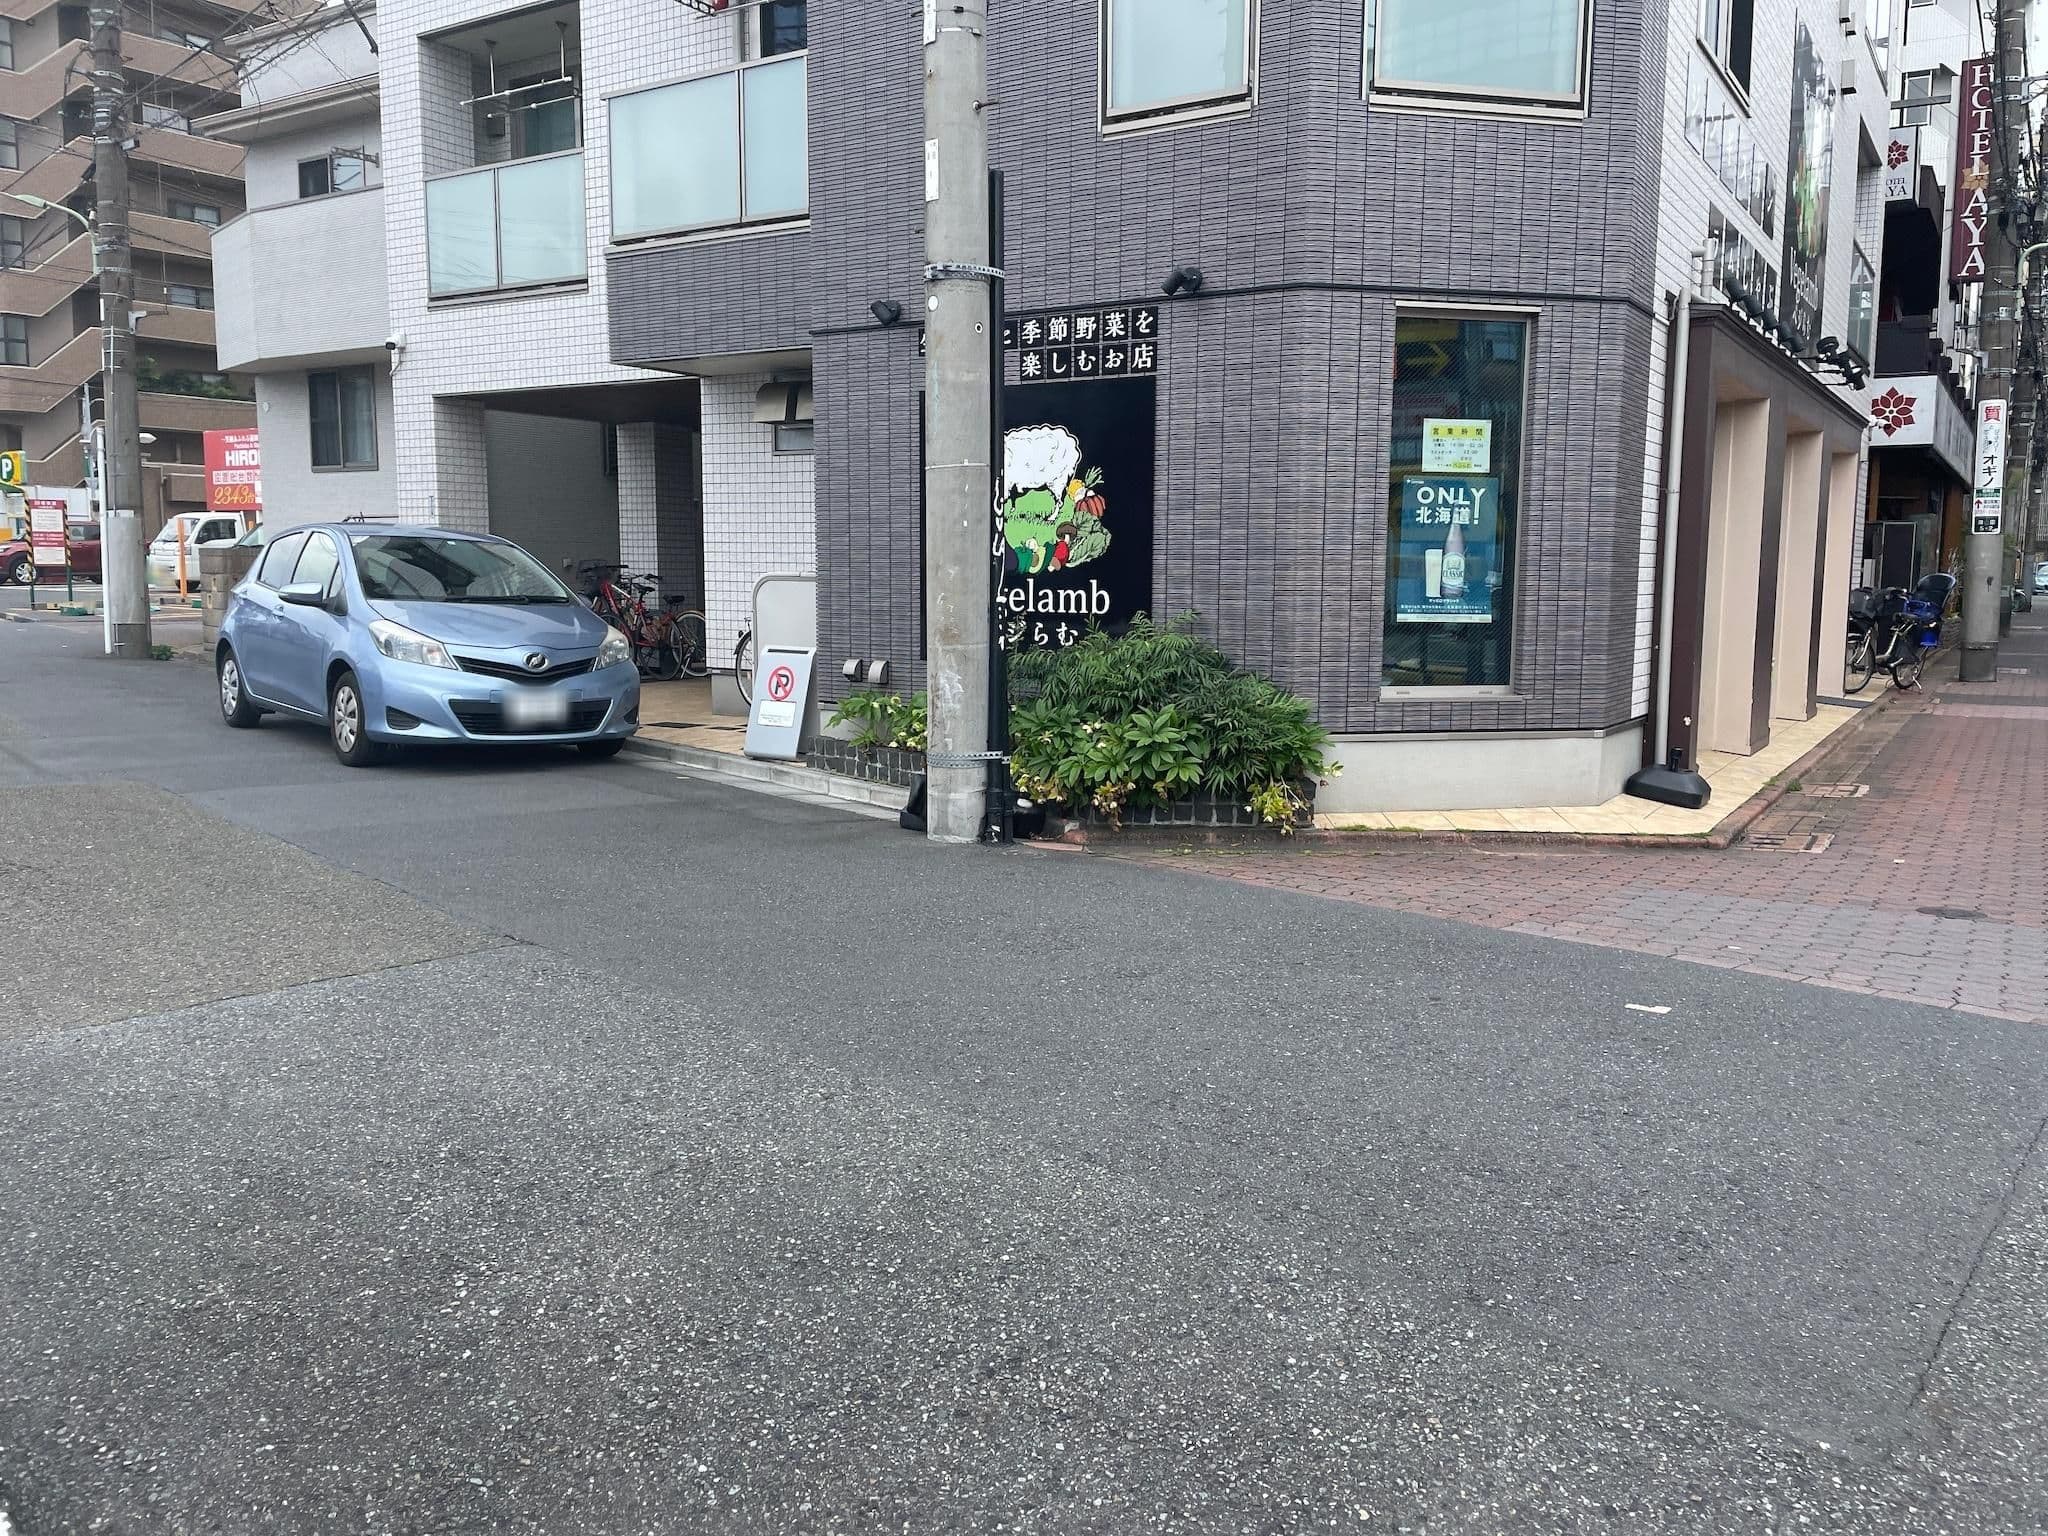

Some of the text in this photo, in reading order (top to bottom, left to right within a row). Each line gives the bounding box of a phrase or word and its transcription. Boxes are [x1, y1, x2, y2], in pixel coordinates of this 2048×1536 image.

[1885, 177, 1905, 186] OTEL
[1957, 64, 1995, 277] HOTEL AYA
[1885, 185, 1907, 197] YA
[1021, 343, 1154, 378] 楽しむお店
[1984, 405, 2000, 422] 質
[1982, 454, 1998, 487] オギノ
[1004, 578, 1111, 615] elamb
